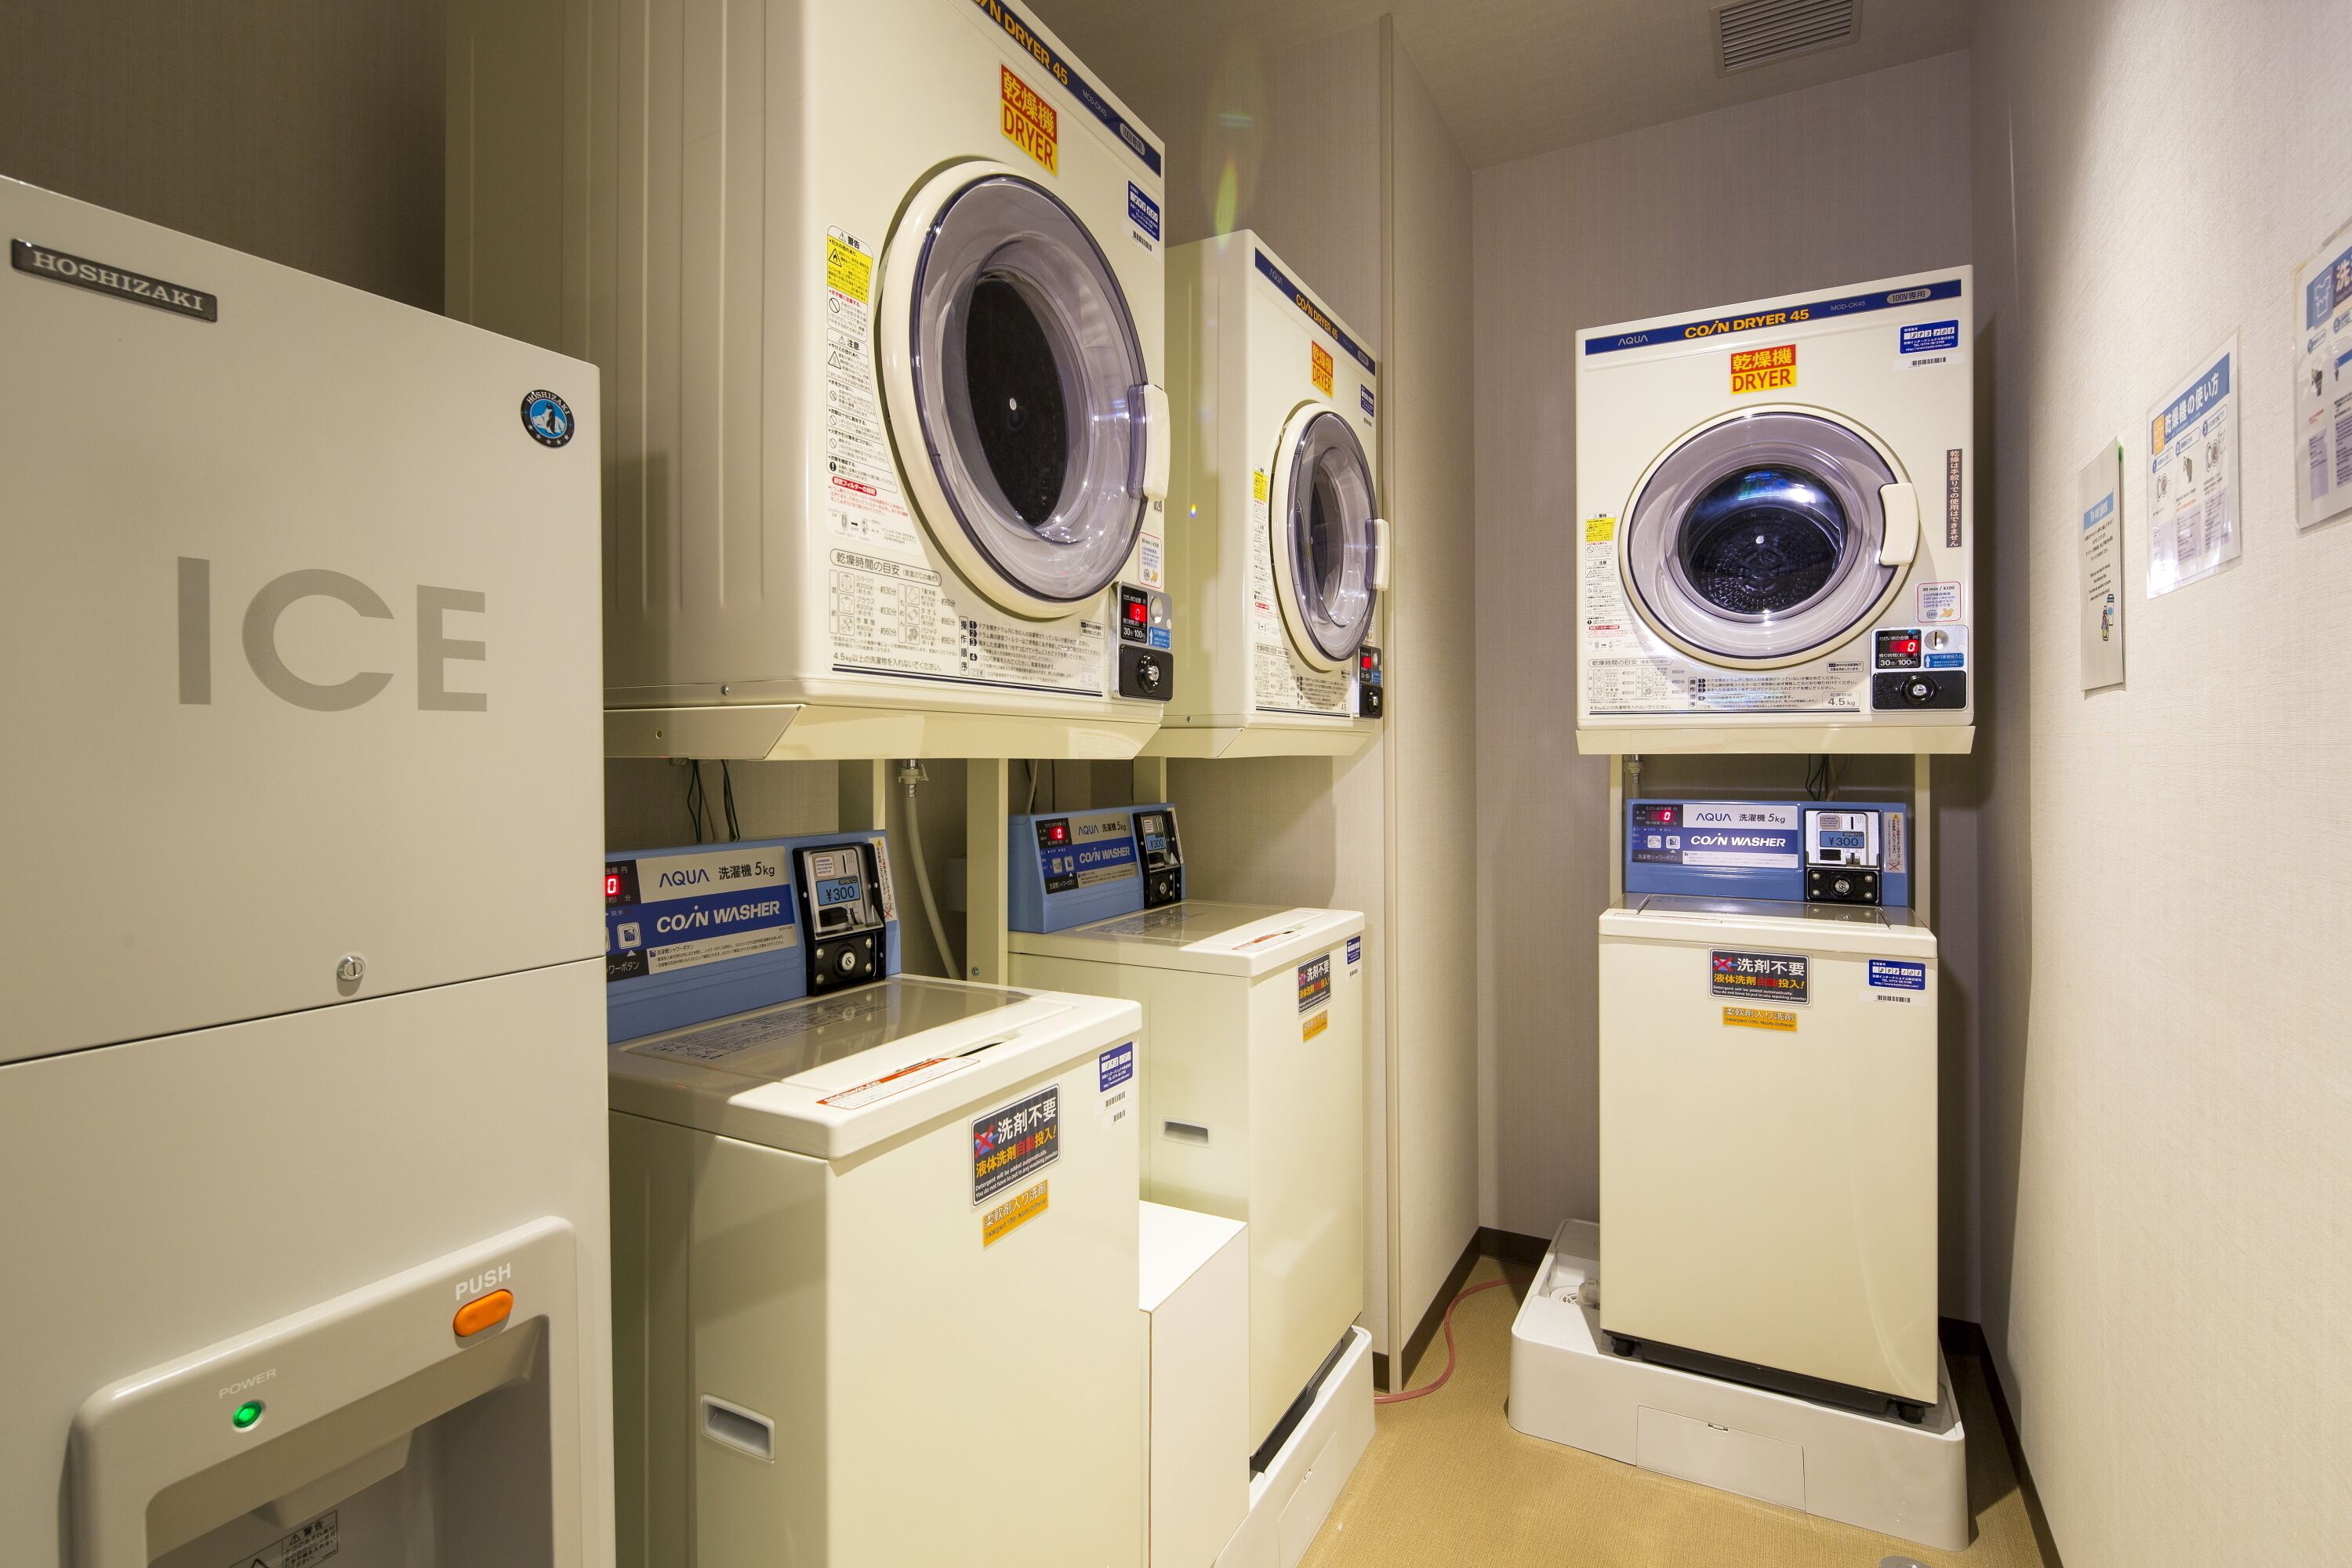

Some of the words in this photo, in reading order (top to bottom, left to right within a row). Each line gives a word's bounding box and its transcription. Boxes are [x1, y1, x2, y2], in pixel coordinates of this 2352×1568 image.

[1005, 13, 1050, 69] DRYER
[1053, 63, 1068, 85] 45
[1004, 71, 1054, 135] 乾燥機
[1004, 104, 1054, 171] DRYER
[848, 236, 860, 249] 警告
[31, 251, 204, 312] HOSHIZAKI
[1269, 267, 1283, 287] AQUA
[1313, 311, 1331, 334] DRYER
[1332, 328, 1338, 339] 45
[1892, 290, 1926, 302] 100V専用
[1618, 336, 1648, 346] AQUA
[1733, 314, 1786, 332] DRYER
[1790, 309, 1809, 321] 45
[1830, 300, 1865, 311] MCD-CK45
[847, 338, 860, 350] 注意
[1312, 345, 1332, 375] 乾燥機
[1733, 348, 1792, 372] 乾燥機
[1312, 368, 1331, 395] DRYER
[1733, 369, 1791, 393] DRYER
[526, 391, 570, 415] HOSHIZAKI
[2165, 372, 2219, 435] 乾燥機の使い方
[837, 553, 900, 575] 乾燥時間の目安
[177, 556, 488, 712] ICE
[1907, 642, 1915, 652] 0
[1078, 825, 1099, 837] AQUA
[1102, 822, 1116, 833] 洗濯機
[1117, 822, 1127, 831] 5kg
[1696, 813, 1732, 822] AQUA
[1739, 813, 1766, 822] 洗濯機
[1768, 813, 1786, 825] 5kg
[1057, 829, 1062, 839] 0
[1150, 840, 1163, 849] ¥300
[1731, 837, 1786, 848] WASHER
[1829, 837, 1859, 847] ¥300
[1102, 847, 1131, 861] WASHER
[607, 878, 617, 894] 0
[659, 869, 710, 888] AQUA
[718, 864, 752, 881] 洗濯機
[755, 862, 775, 877] 5kg
[826, 886, 855, 902] ¥300
[713, 900, 780, 924] WASHER
[607, 961, 640, 975] ワーボタン
[1737, 958, 1805, 976] 洗剤不要
[1714, 974, 1805, 989] 液体洗剤自動投入!
[1725, 1007, 1794, 1022] 柔軟剤入り洗剤
[997, 1096, 1057, 1144] 洗剤不要
[975, 1125, 1057, 1178] 液体洗剤自動投入!
[975, 1177, 996, 1191] Detergent
[1010, 1163, 1022, 1174] added
[997, 1178, 1007, 1189] have
[1029, 1158, 1045, 1169] washing
[985, 1182, 1046, 1229] 柔軟剤入り洗剤
[456, 1263, 511, 1301] PUSH
[219, 1368, 276, 1399] POWER
